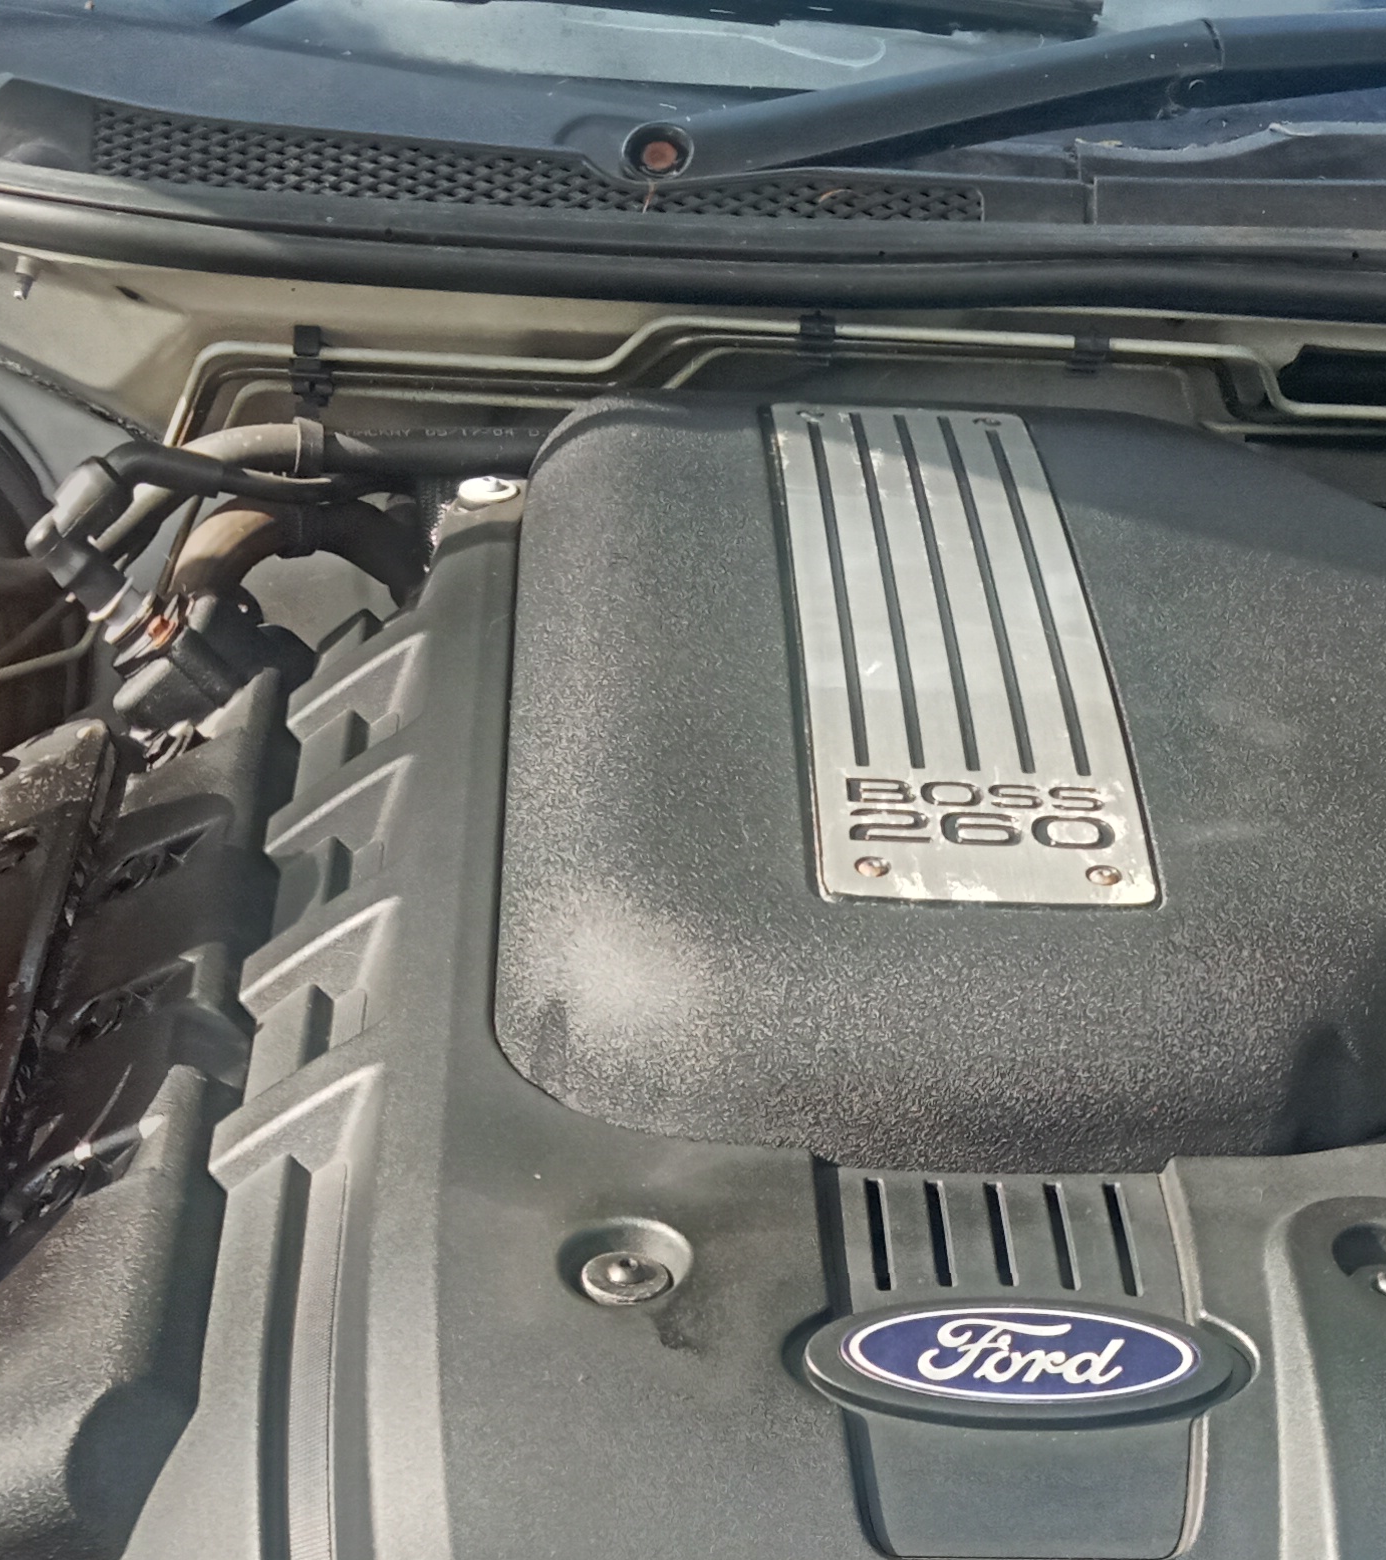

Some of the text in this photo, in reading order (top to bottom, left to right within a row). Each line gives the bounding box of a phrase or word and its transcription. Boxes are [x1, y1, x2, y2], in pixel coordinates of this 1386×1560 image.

[845, 777, 1106, 811] BOSS
[849, 808, 1116, 850] 260
[917, 1317, 1125, 1385] Ford
